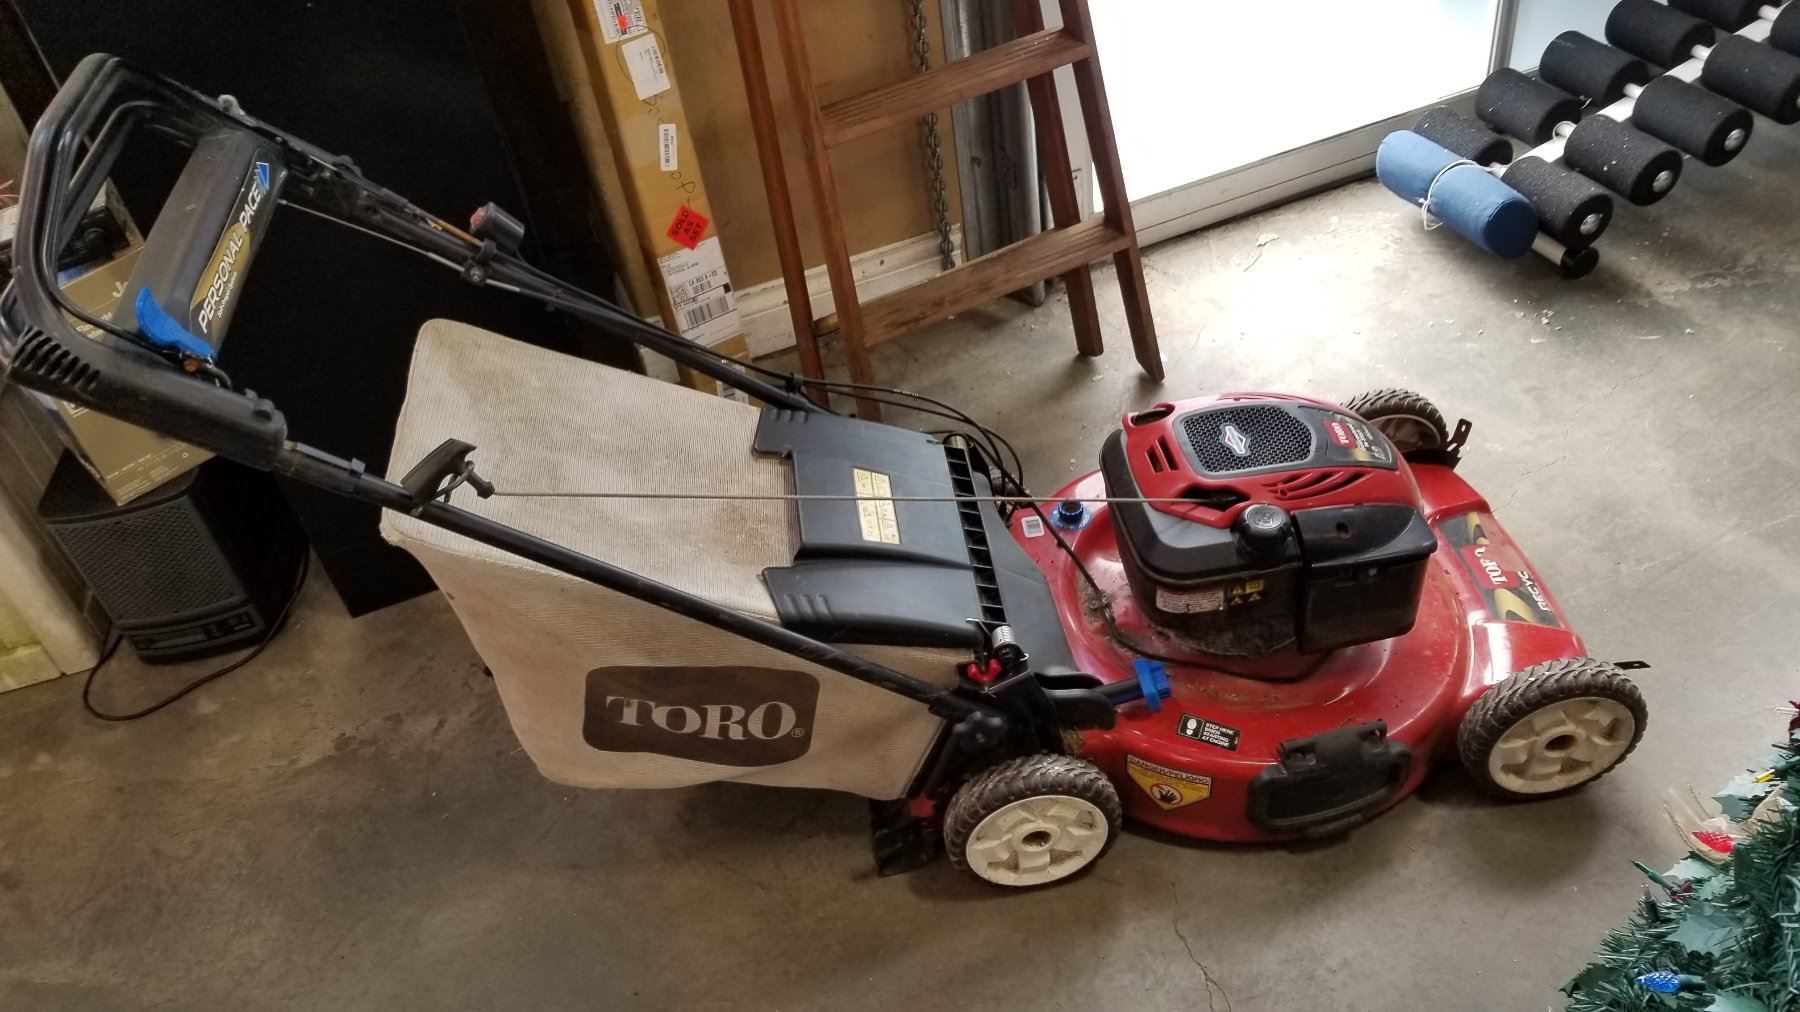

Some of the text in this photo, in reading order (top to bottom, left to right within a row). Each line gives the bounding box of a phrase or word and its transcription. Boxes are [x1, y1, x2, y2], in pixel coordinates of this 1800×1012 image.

[672, 210, 689, 237] SOLD
[684, 220, 694, 235] AS
[690, 222, 702, 242] SET
[198, 232, 243, 334] PERSONAL
[239, 183, 262, 232] PACE
[605, 695, 798, 740] TORO
[1203, 731, 1229, 742] STARTING
[1204, 727, 1220, 735] WHEN
[1205, 722, 1234, 735] STEP HERE
